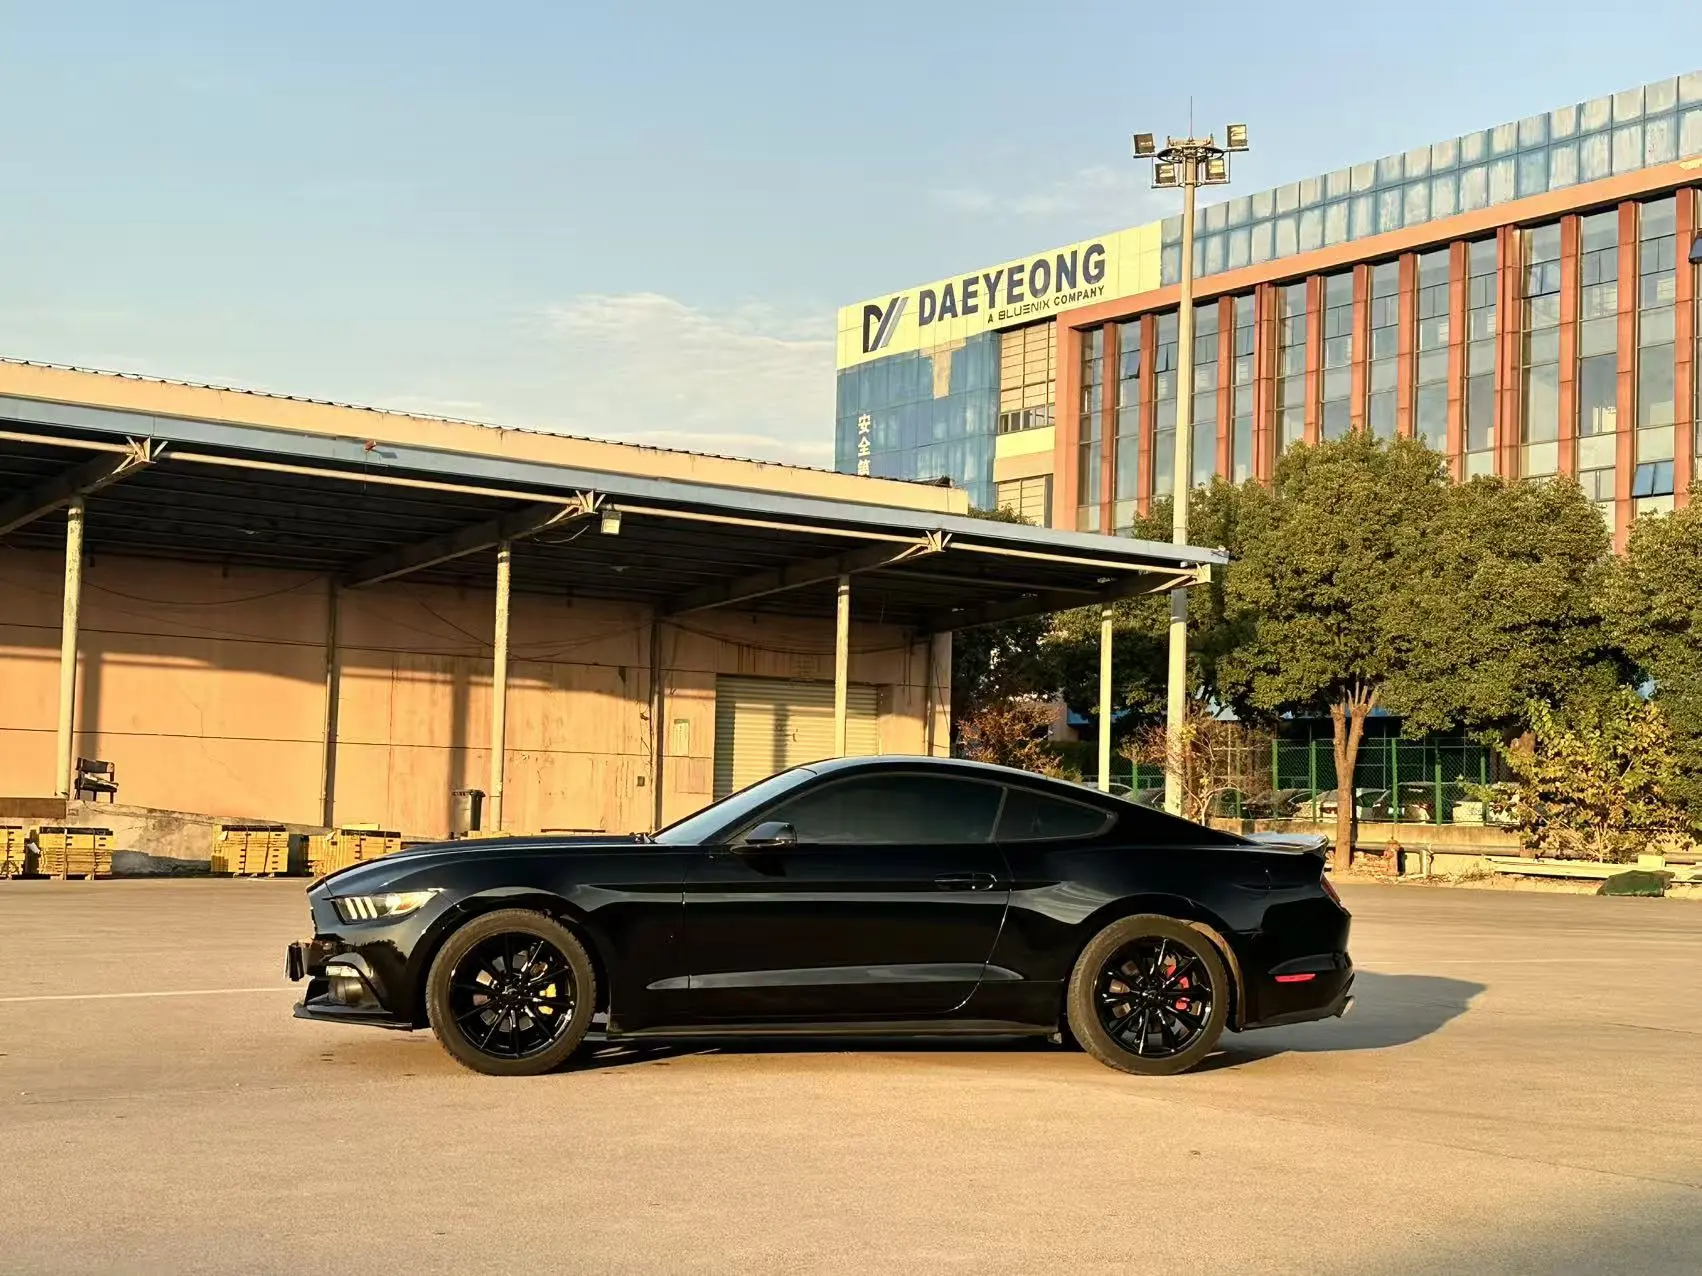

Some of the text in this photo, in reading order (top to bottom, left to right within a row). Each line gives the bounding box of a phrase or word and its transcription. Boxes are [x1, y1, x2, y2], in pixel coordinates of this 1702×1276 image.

[918, 243, 1105, 327] DAEYEONG
[987, 285, 1105, 324] A BLUENIX COMPANY
